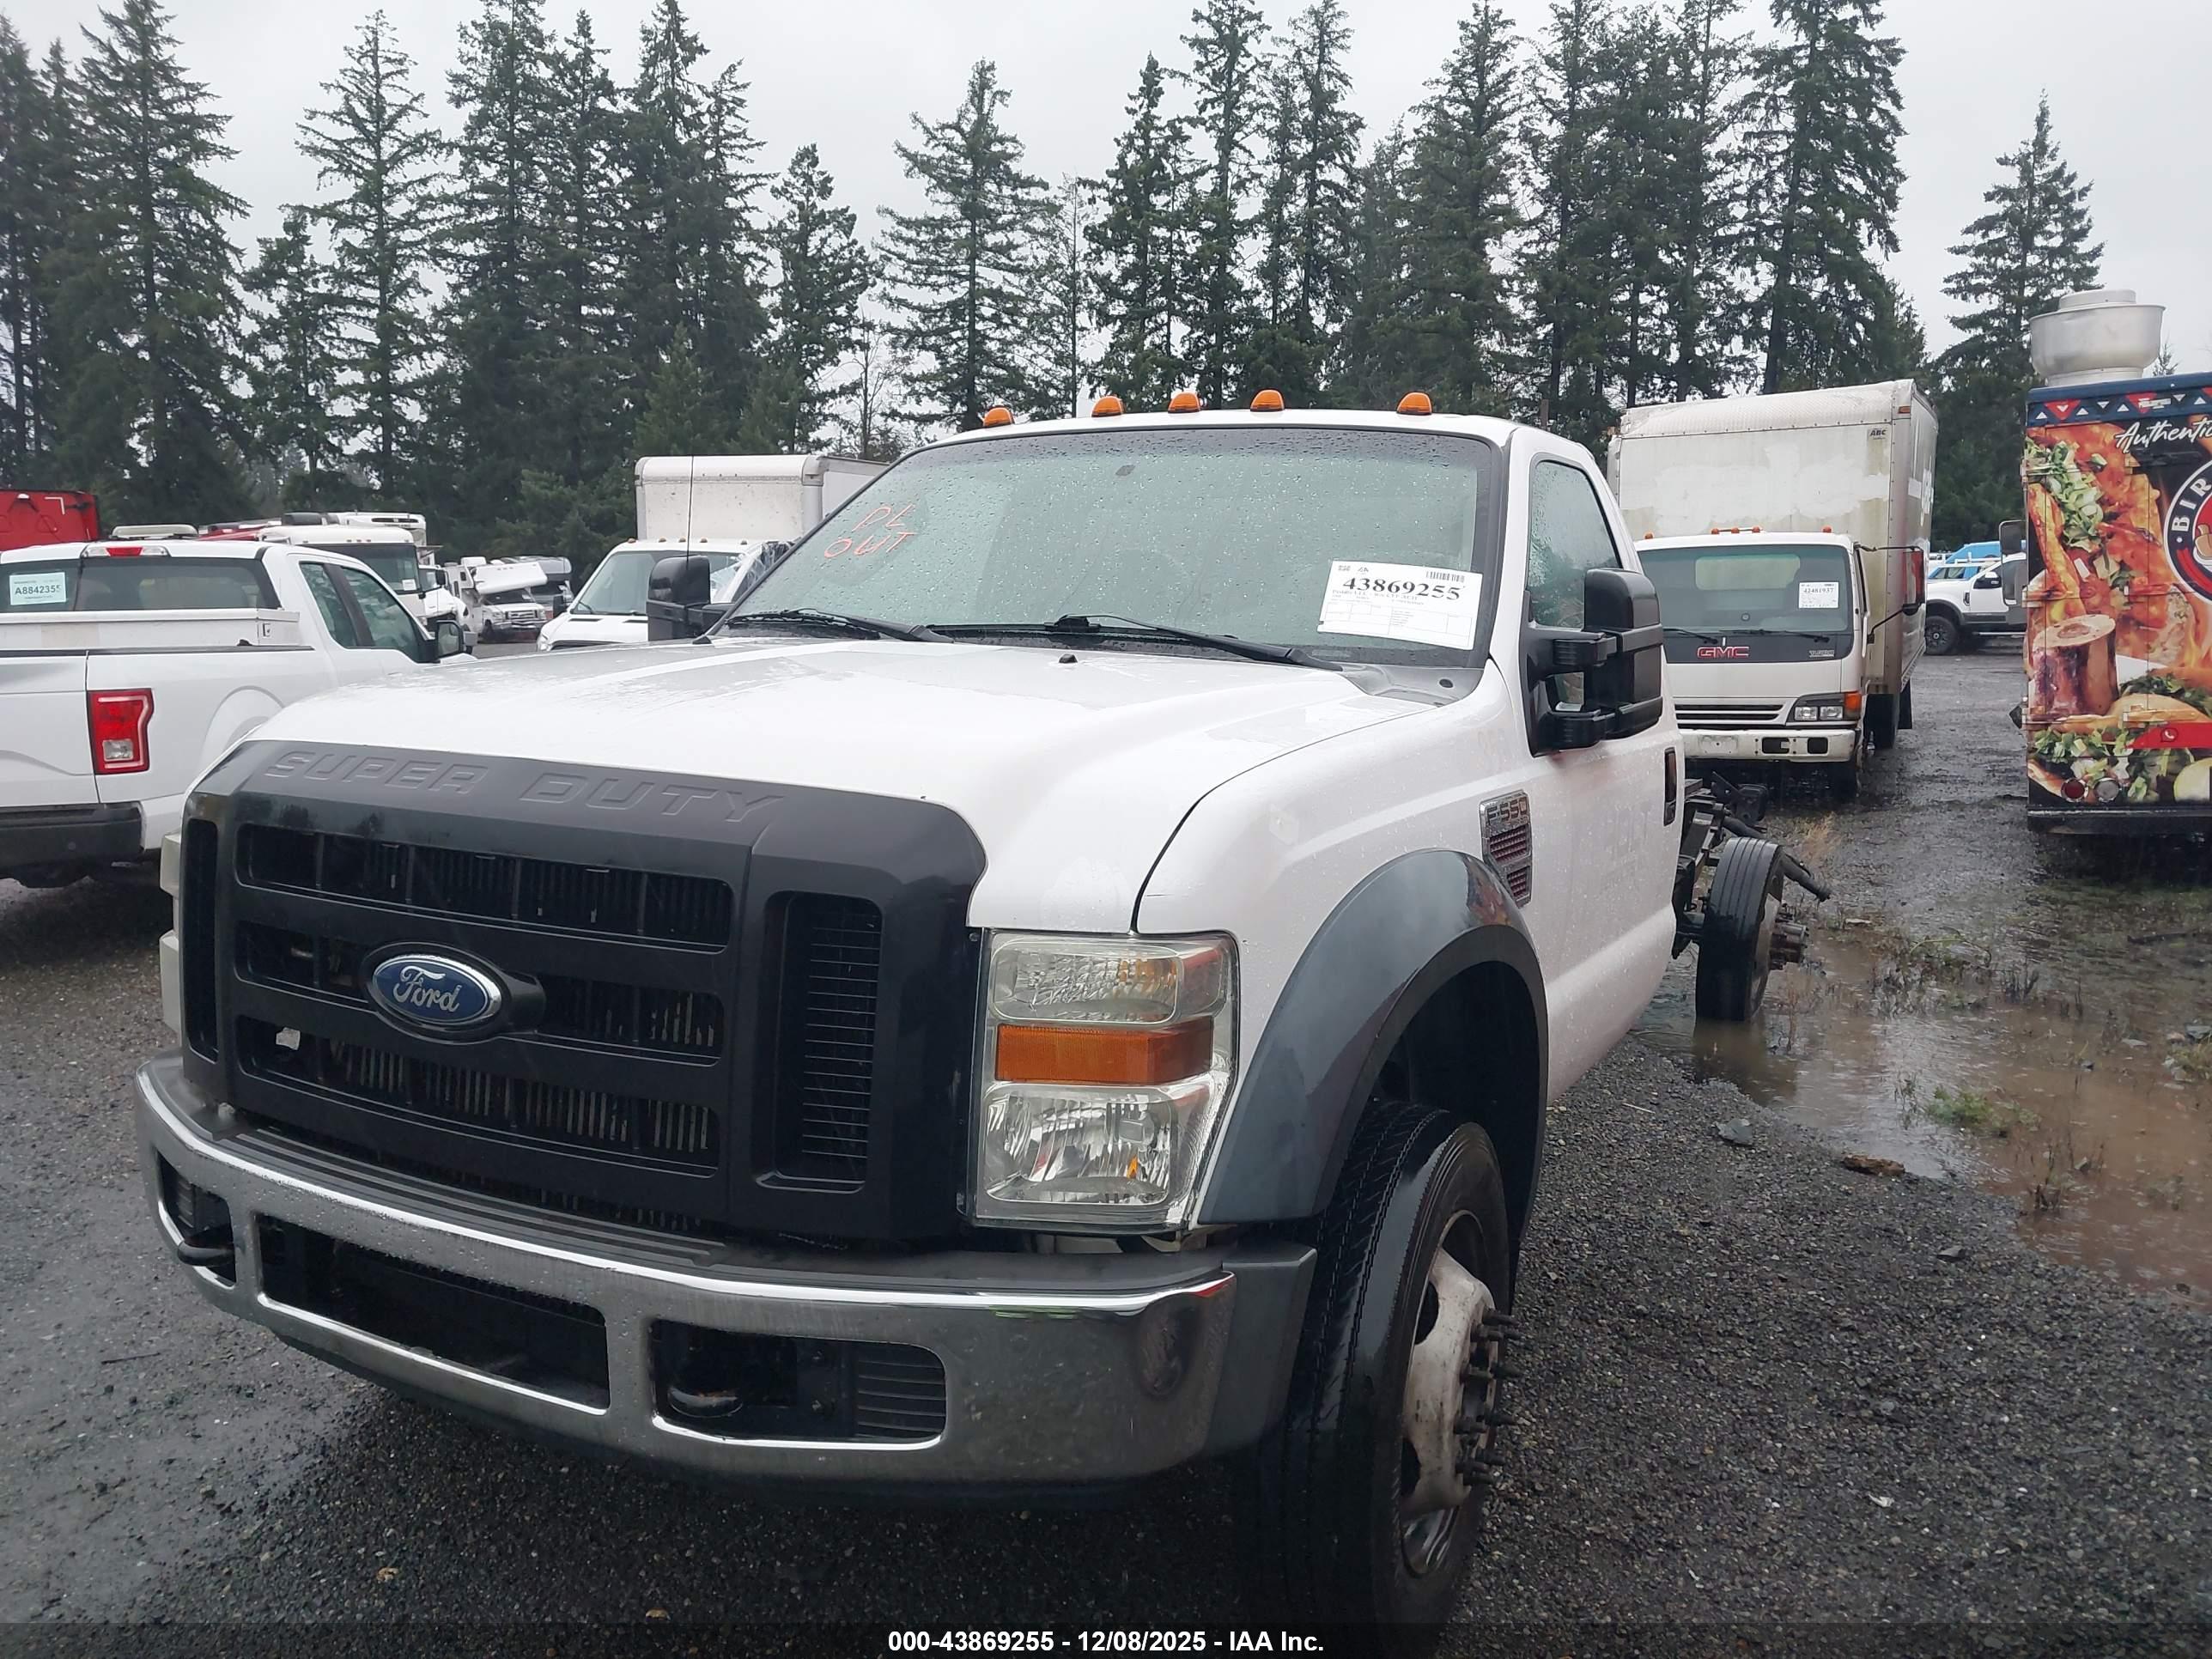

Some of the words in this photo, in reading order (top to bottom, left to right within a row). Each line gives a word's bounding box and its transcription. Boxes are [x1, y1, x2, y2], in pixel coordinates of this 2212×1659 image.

[823, 531, 920, 558] OUT
[1342, 577, 1462, 600] 43869255
[1697, 647, 1750, 659] GMC
[264, 750, 489, 795] SUPER
[519, 772, 785, 823] DUTY
[392, 965, 463, 1012] Ford
